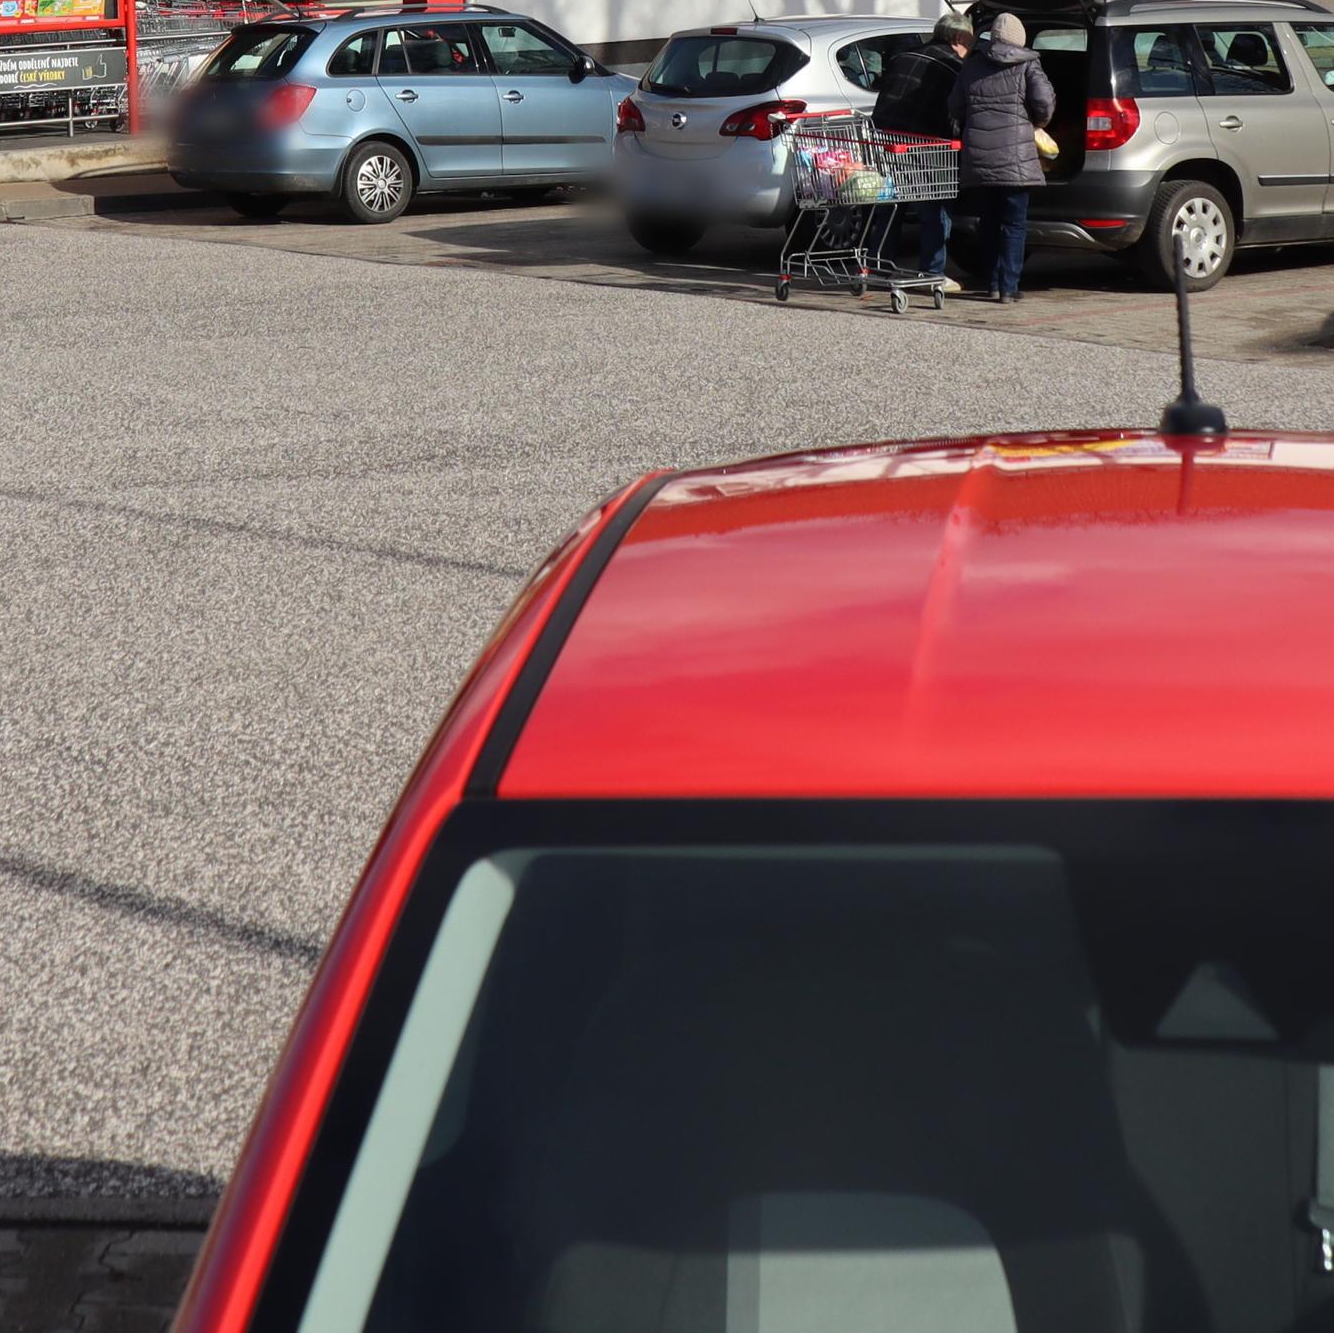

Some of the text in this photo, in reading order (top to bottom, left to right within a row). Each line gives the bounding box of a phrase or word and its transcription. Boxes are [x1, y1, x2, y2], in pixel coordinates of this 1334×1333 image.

[19, 57, 50, 71] ODDĚLENÍ
[51, 57, 79, 69] NAJDETE
[0, 68, 65, 84] DOBRÉ ČESKÉ VÝROBKY
